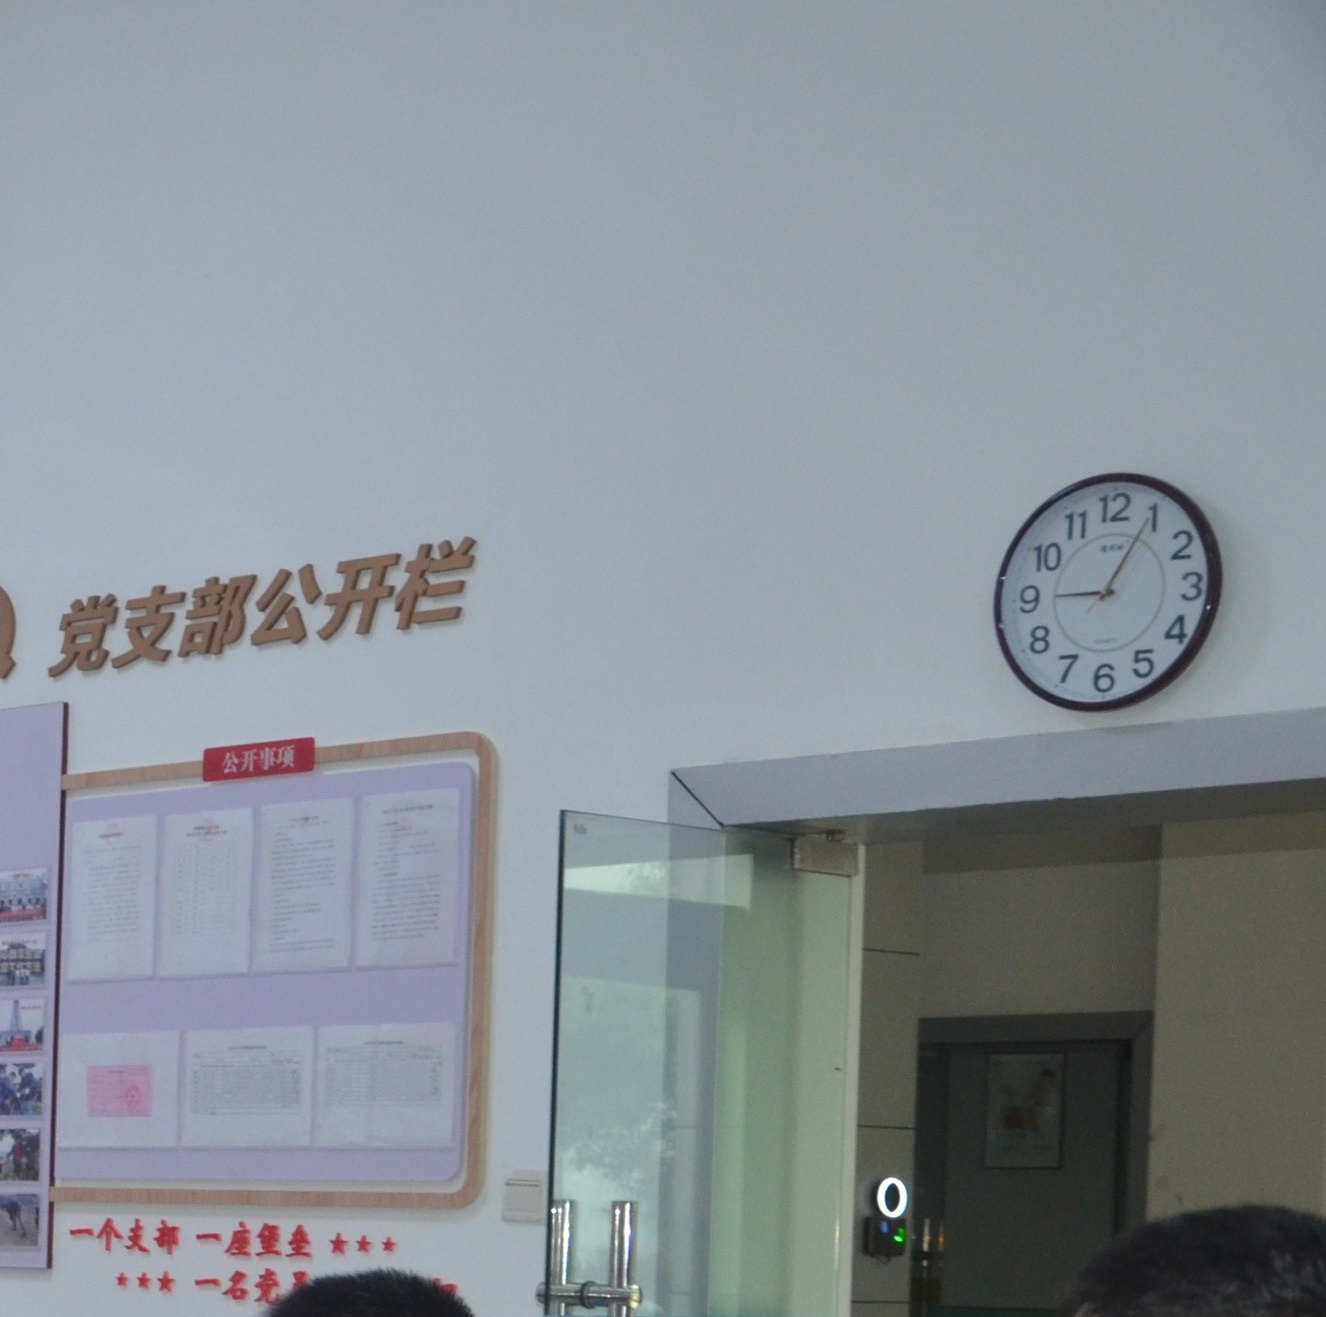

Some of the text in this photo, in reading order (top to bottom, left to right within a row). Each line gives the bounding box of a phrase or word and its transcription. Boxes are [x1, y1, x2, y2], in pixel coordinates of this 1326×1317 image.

[1099, 493, 1131, 523] 12
[1148, 503, 1159, 532] 1
[1065, 510, 1088, 540] 11
[1033, 542, 1062, 572] 10
[1170, 530, 1194, 561] 2
[1019, 585, 1041, 614] 9
[1180, 572, 1203, 601] 3
[48, 536, 477, 678] 党支部公开栏
[1029, 625, 1051, 654] 8
[1164, 614, 1188, 644] 4
[1059, 654, 1079, 684] 7
[1093, 664, 1115, 693] 6
[1132, 649, 1154, 678] 5
[222, 745, 295, 773] 公开事项
[69, 1217, 313, 1258] 一个支部 一座堡垒
